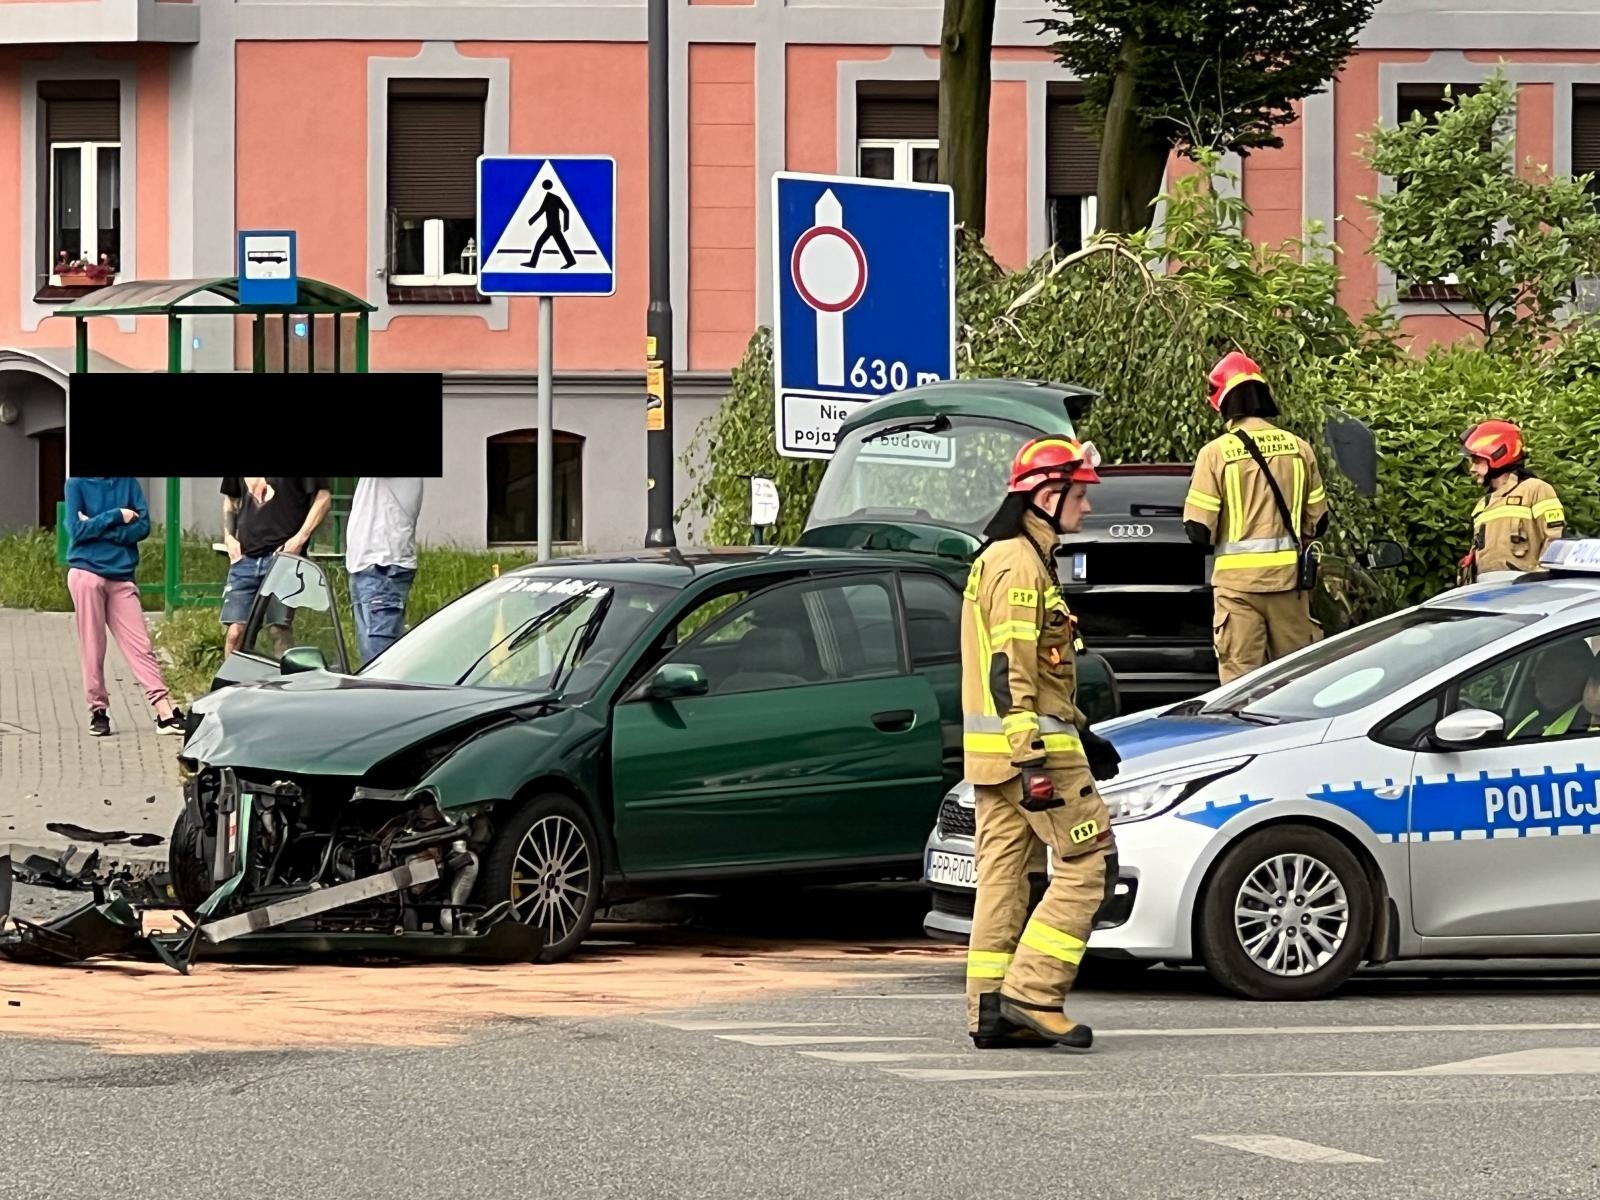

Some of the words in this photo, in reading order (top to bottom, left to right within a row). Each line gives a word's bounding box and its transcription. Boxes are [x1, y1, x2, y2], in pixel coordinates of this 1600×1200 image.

[850, 357, 908, 390] 630
[916, 371, 941, 387] m
[820, 404, 848, 421] Nie
[795, 427, 838, 445] pojaz
[880, 434, 941, 454] budowy
[1013, 591, 1033, 603] PSP
[1485, 780, 1600, 823] POLICJ
[1073, 823, 1094, 841] PSP
